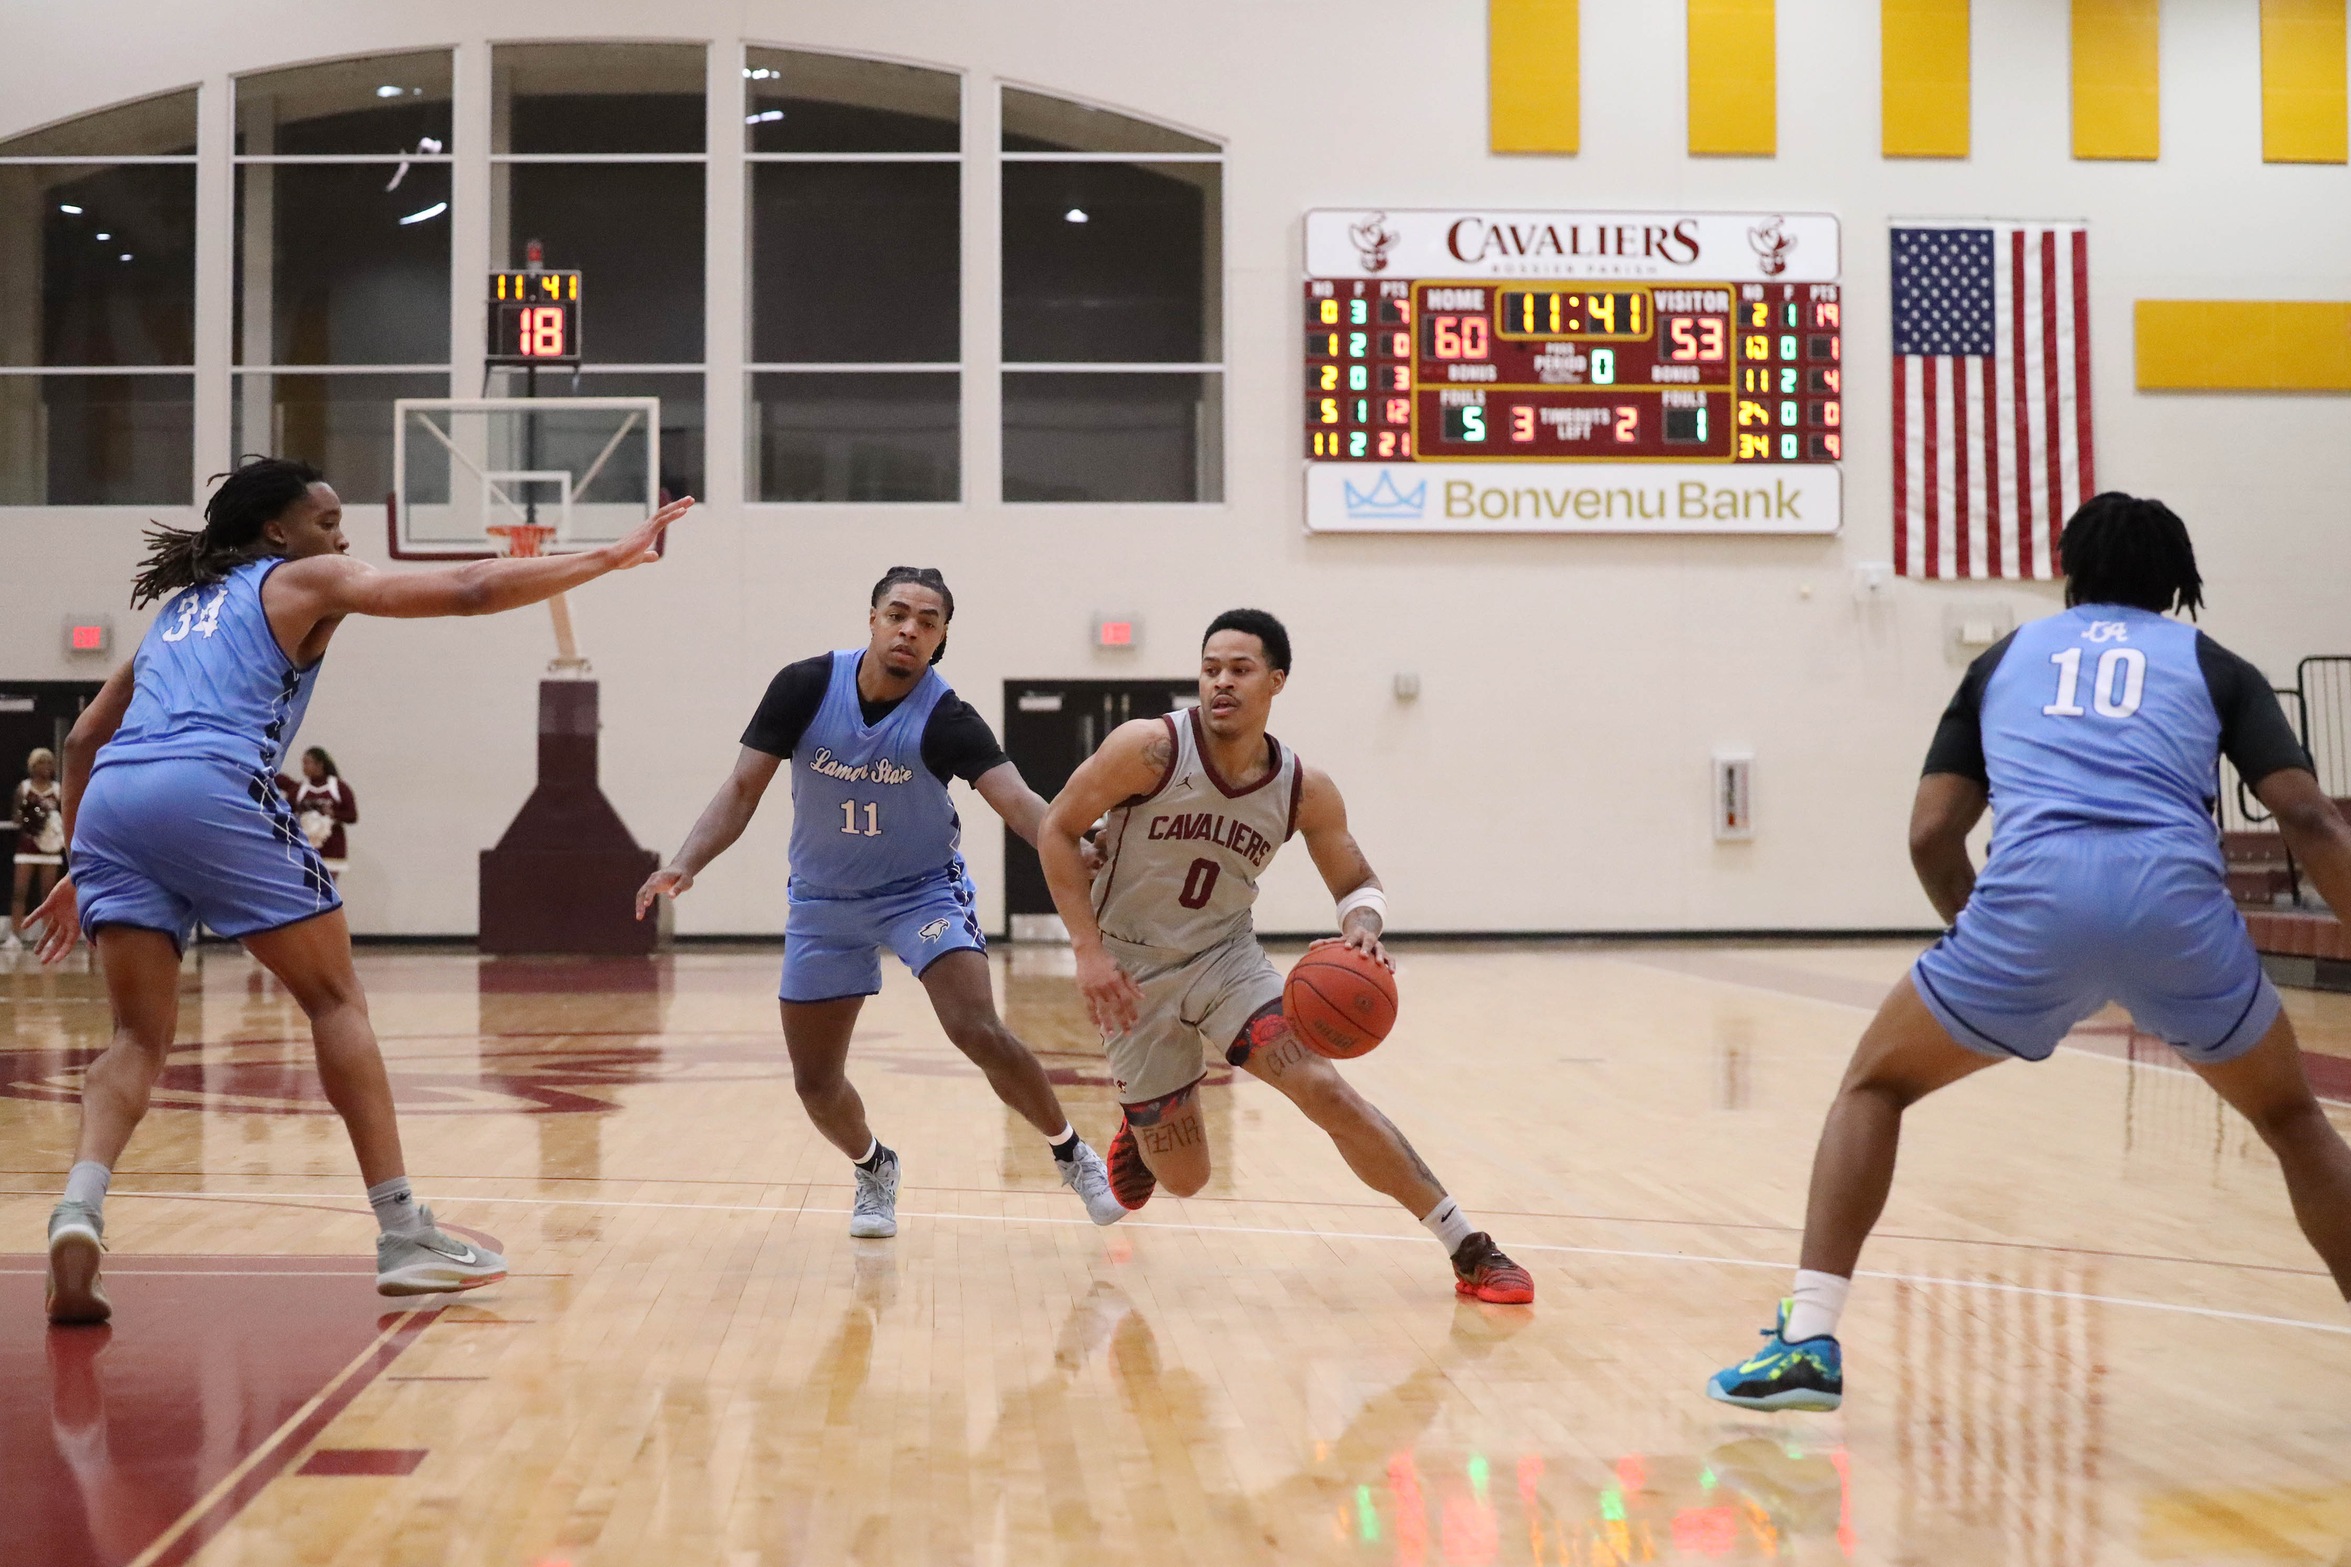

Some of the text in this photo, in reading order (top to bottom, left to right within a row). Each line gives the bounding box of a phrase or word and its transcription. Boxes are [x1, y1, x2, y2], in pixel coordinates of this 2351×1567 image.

[1447, 216, 1700, 266] CAVALIERS
[1321, 299, 1410, 325] 0 3 7
[1427, 288, 1485, 311] HOME
[1523, 292, 1641, 335] 11:41
[1654, 290, 1729, 313] VISITOR
[1752, 302, 1839, 328] 2 1 19
[520, 307, 565, 356] 18
[1328, 332, 1410, 358] 1 2 0
[1434, 316, 1488, 359] 60
[1671, 317, 1724, 361] 53
[1780, 335, 1797, 361] 0
[1831, 335, 1840, 361] 1
[1321, 365, 1410, 391] 2 0 3
[1591, 348, 1614, 385] 0
[1746, 368, 1840, 393] 11 2 4
[1321, 398, 1410, 424] 5 1 12
[1462, 405, 1486, 442] 5
[1512, 406, 1535, 442] 3
[1539, 407, 1611, 425] TIMEOUTS
[1615, 406, 1638, 443] 2
[1696, 407, 1707, 442] 1
[1781, 400, 1798, 426] 0
[1824, 400, 1840, 426] 0
[1314, 432, 1410, 457] 11 2 21
[1557, 422, 1592, 441] LEFT
[1738, 433, 1840, 459] 34 0 9
[1444, 478, 1802, 520] Bonvenu Bank
[162, 588, 229, 642] 34
[2042, 647, 2147, 719] 10
[809, 746, 914, 786] Lamar State
[840, 798, 884, 837] 11
[1148, 813, 1272, 867] CAVALIERS
[1178, 857, 1221, 910] 0
[1142, 1115, 1201, 1154] FEAR
